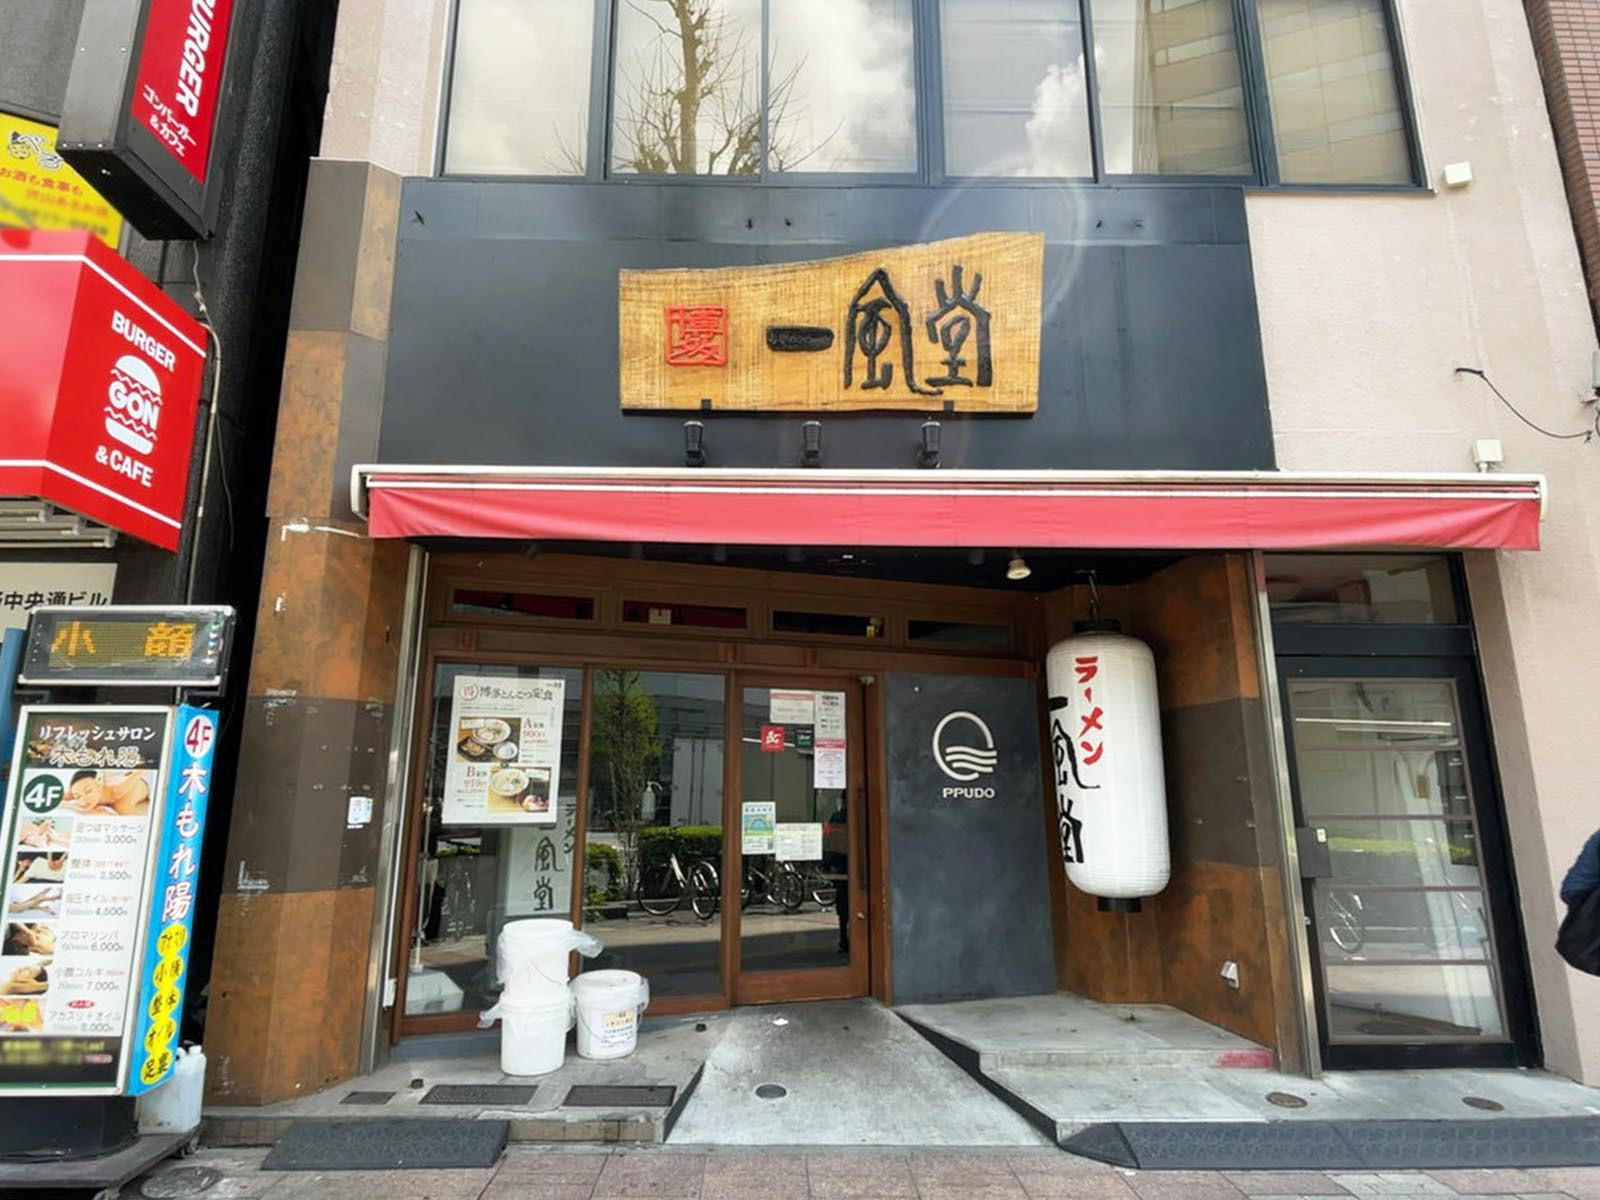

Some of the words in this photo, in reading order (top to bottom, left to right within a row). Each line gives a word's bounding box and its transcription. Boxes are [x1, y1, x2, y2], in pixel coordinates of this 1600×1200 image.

[111, 310, 177, 373] BURGER
[766, 264, 992, 396] 一風堂
[108, 380, 160, 431] GON
[39, 725, 157, 741] リフレッシュサロン
[186, 719, 212, 754] 4F
[1074, 656, 1104, 766] ラーメン
[25, 783, 62, 809] 4F
[942, 787, 996, 799] PPUDO
[161, 761, 208, 924] 木もれ陽
